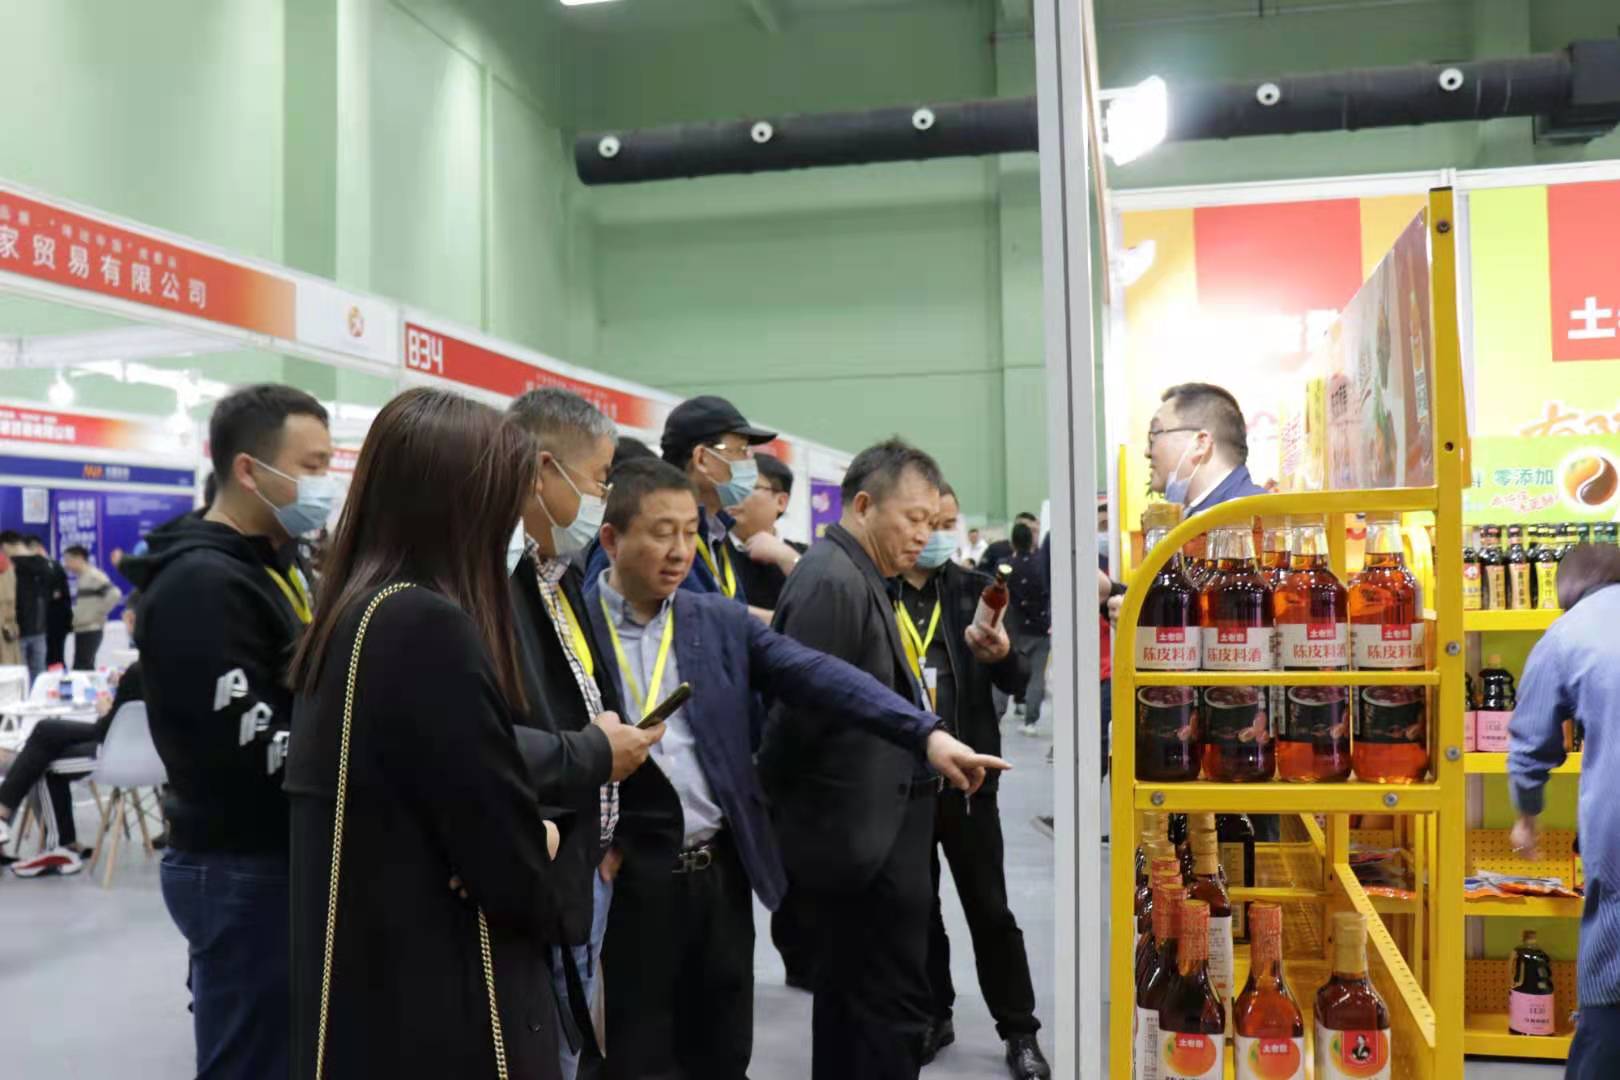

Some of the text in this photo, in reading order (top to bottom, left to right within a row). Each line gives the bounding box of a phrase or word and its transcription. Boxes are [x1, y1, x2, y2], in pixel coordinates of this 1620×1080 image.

[0, 224, 206, 309] 家贸易有限公司
[1567, 296, 1620, 340] 土
[1495, 468, 1554, 487] 零添加
[1143, 647, 1197, 663] 陈皮料酒
[1207, 647, 1262, 664] 陈皮料酒
